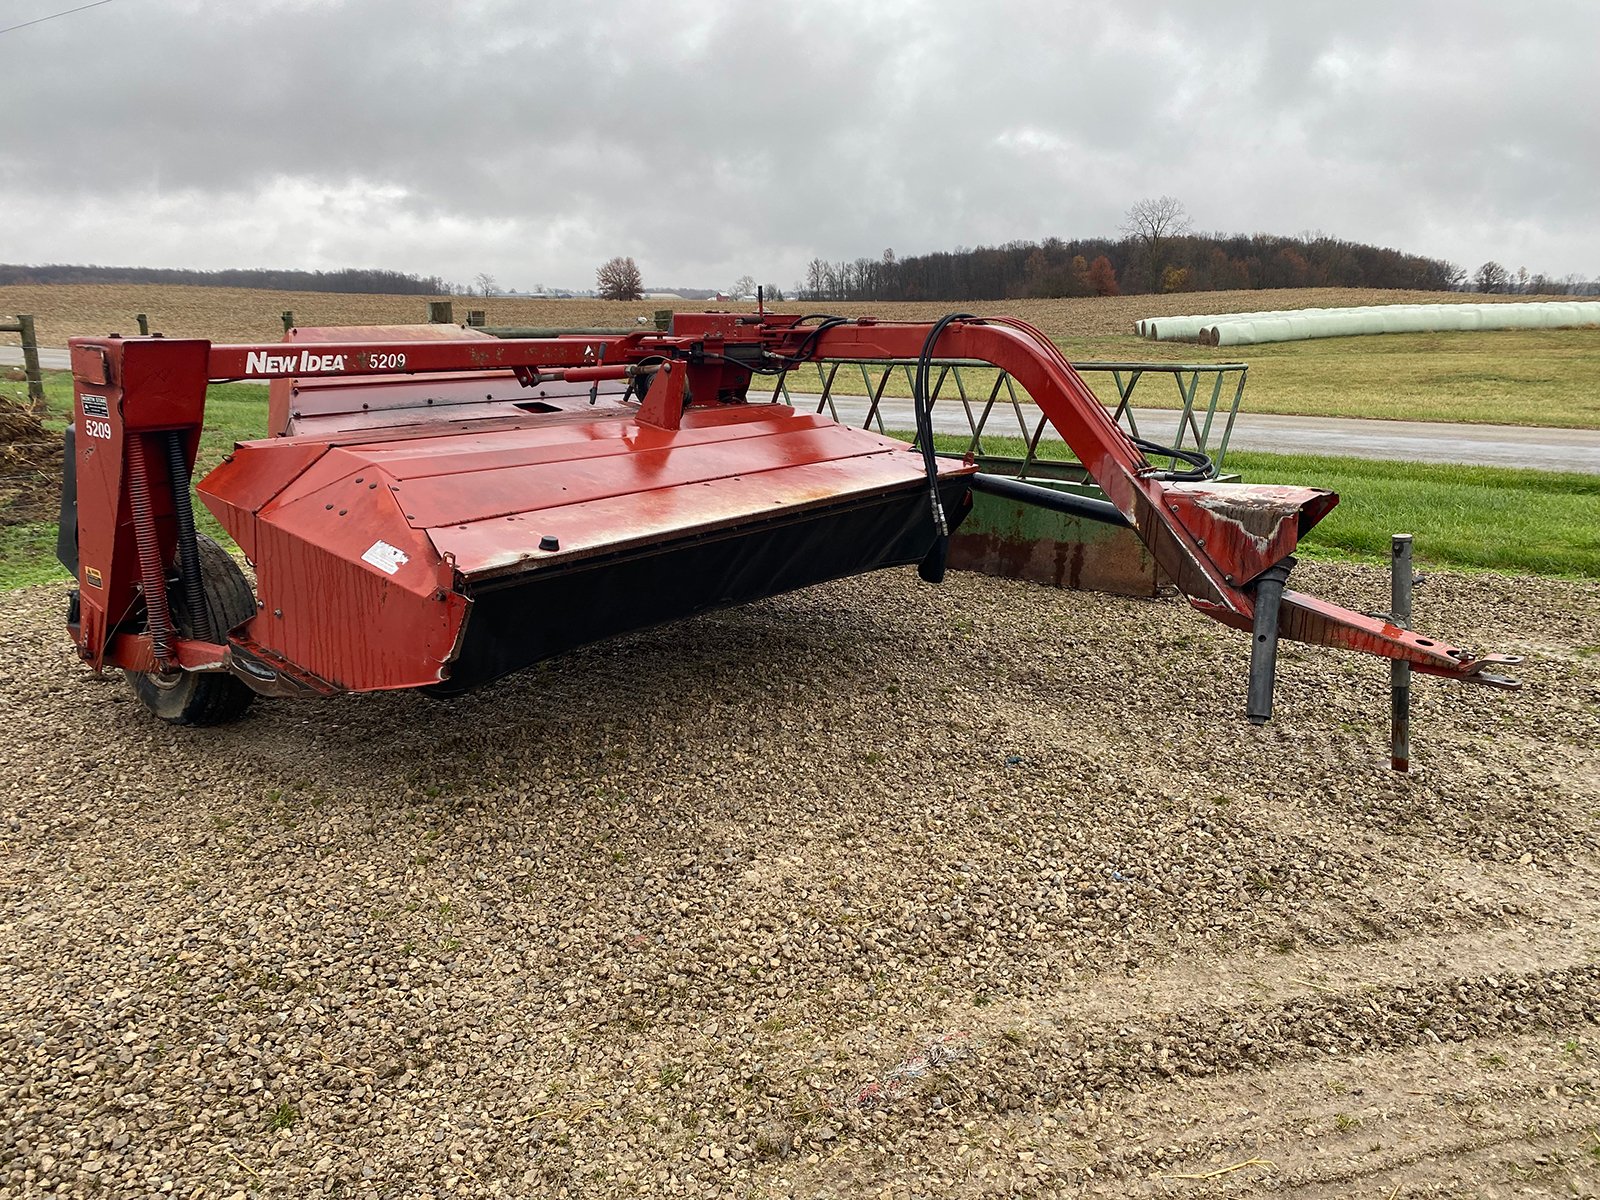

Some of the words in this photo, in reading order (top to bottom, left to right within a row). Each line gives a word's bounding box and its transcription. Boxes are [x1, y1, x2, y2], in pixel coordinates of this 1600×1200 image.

[245, 351, 297, 374] NEW
[299, 350, 345, 372] IDEA
[369, 353, 406, 369] 5209
[86, 419, 111, 440] 5209
